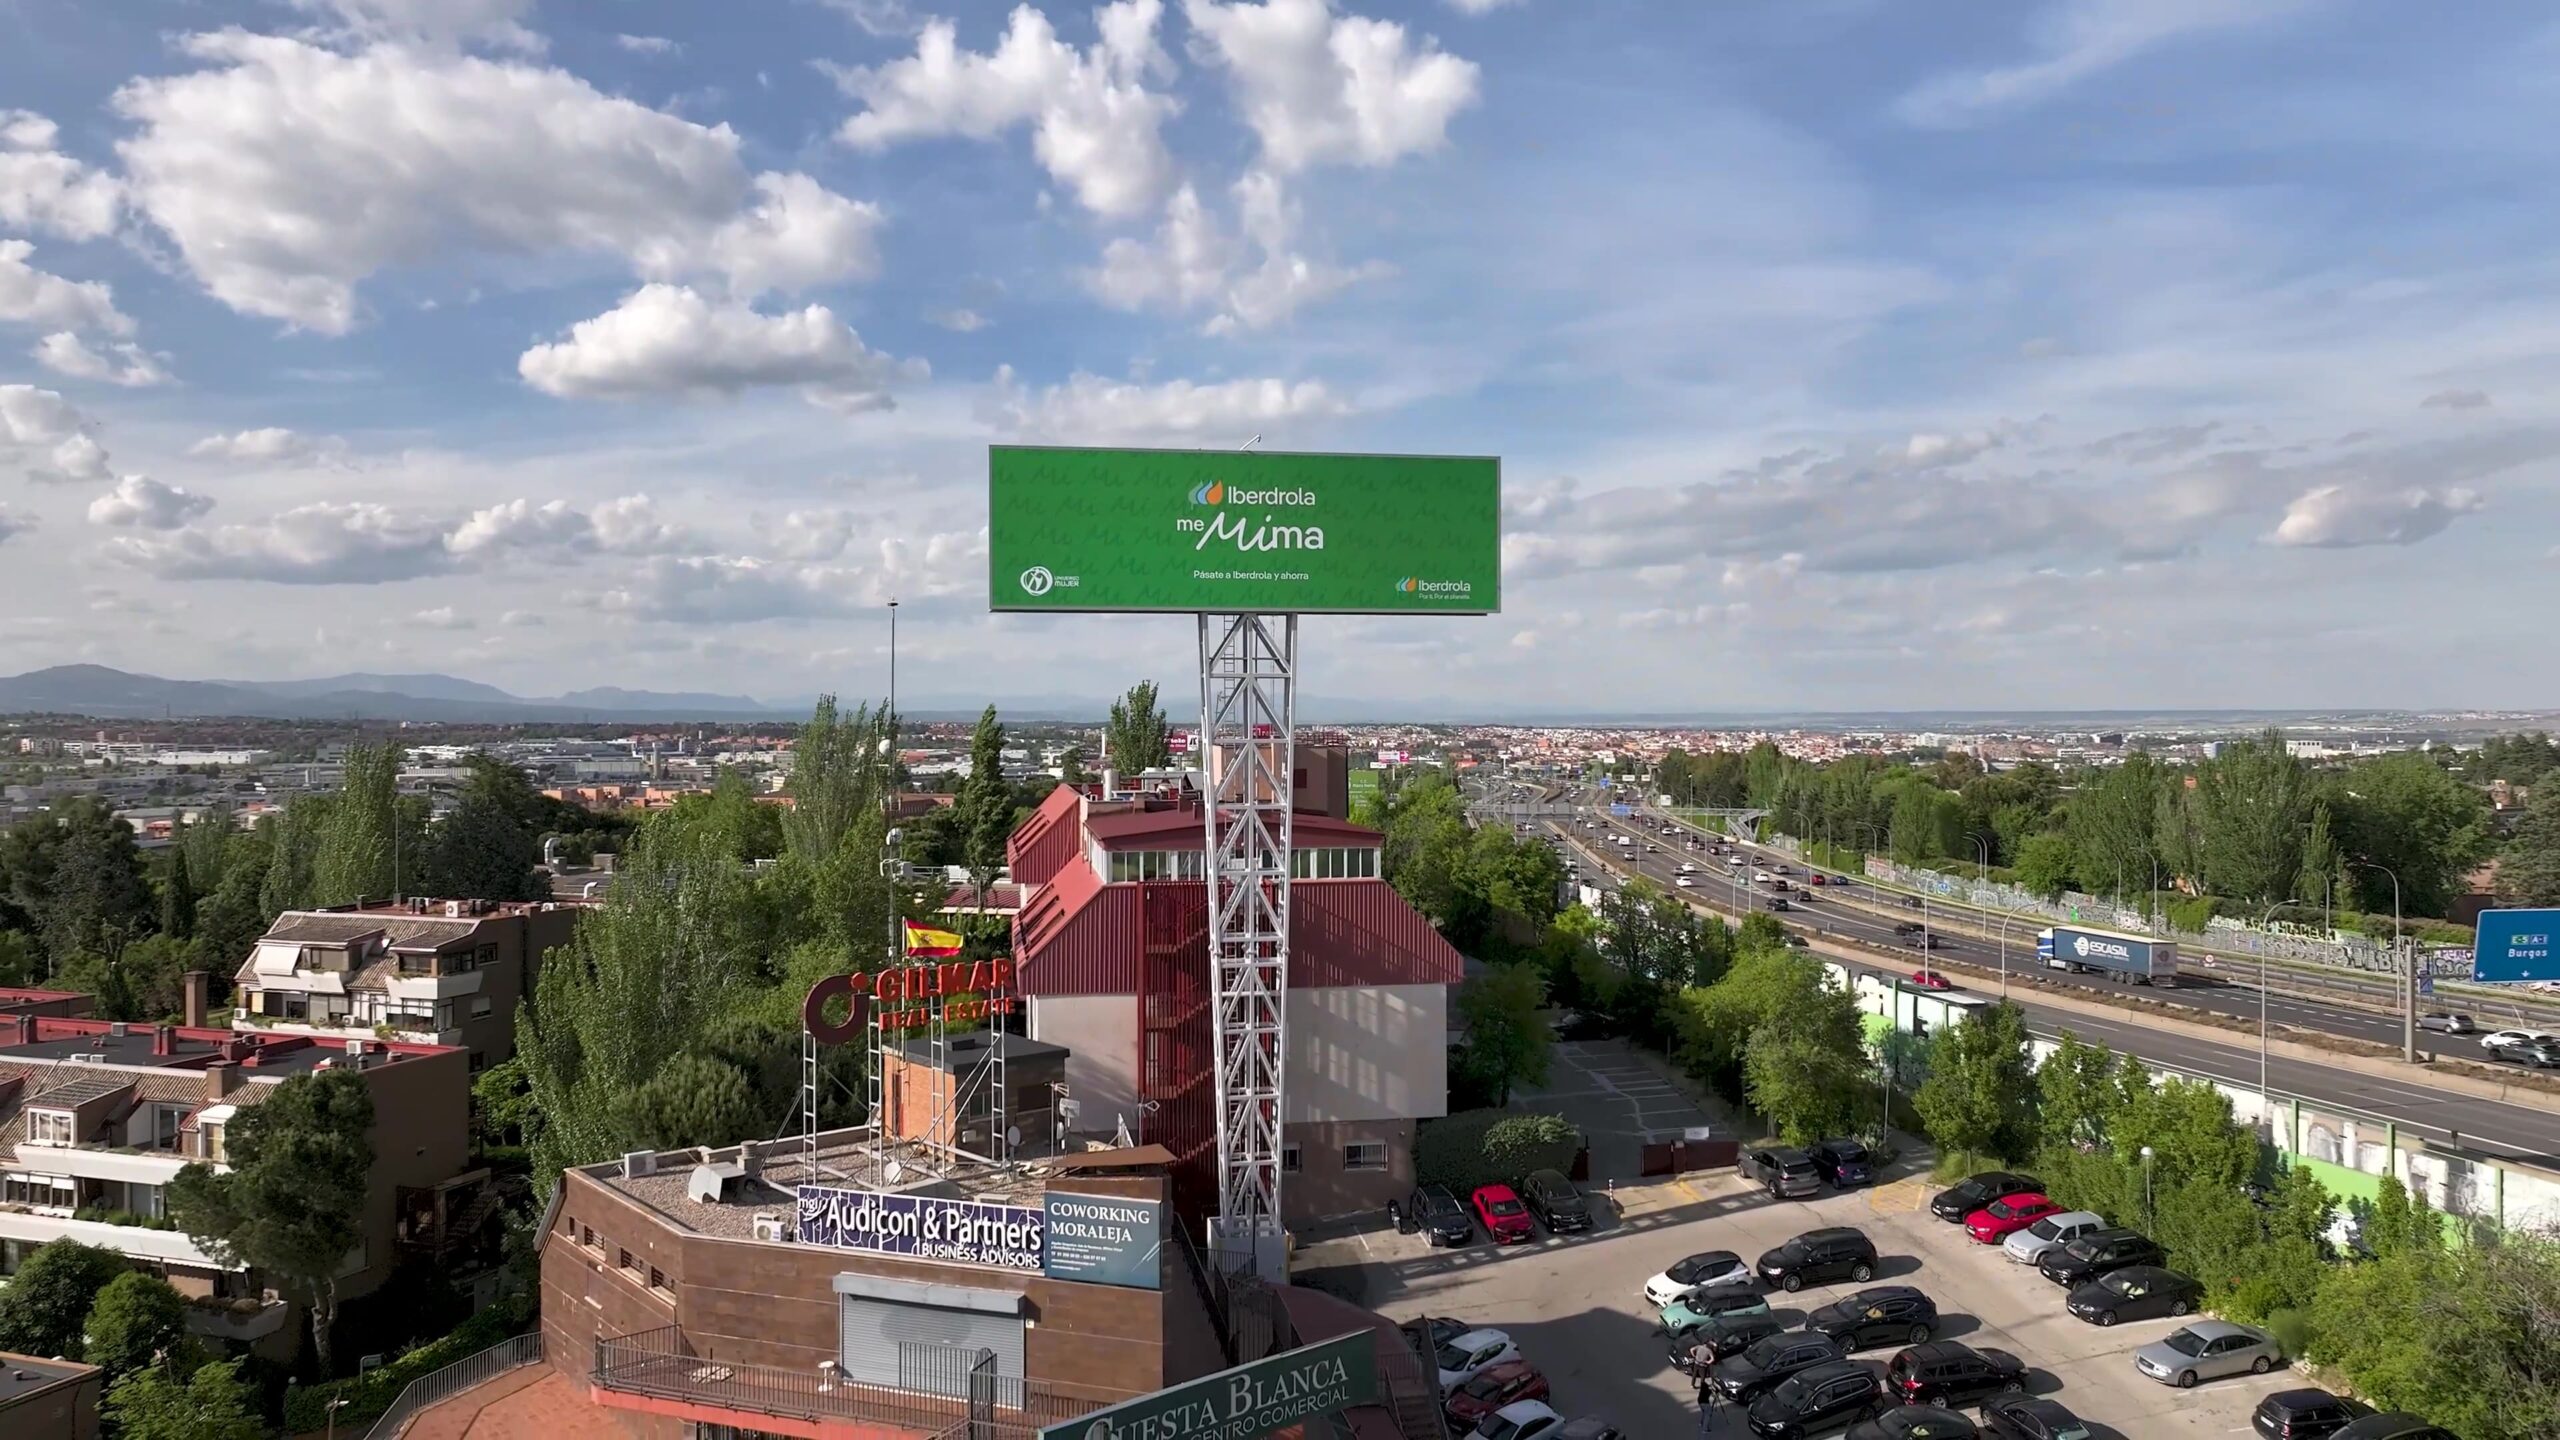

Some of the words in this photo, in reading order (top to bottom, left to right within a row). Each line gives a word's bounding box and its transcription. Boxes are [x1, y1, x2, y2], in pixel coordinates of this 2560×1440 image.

[1228, 486, 1316, 506] Iberdrola
[1176, 518, 1205, 532] me
[1195, 511, 1324, 552] Mima
[1193, 569, 1224, 580] Pásate
[1232, 570, 1273, 580] Iberdrola
[1274, 572, 1280, 582] y
[1280, 571, 1309, 580] ahorra
[1418, 579, 1471, 592] Iberdrola
[2508, 948, 2548, 960] Burgos
[877, 958, 1013, 1002] GILMAR
[944, 997, 1015, 1023] ESTATE
[826, 1196, 917, 1238] Audicon
[923, 1206, 940, 1240] &
[946, 1209, 1041, 1251] Partners
[1050, 1202, 1150, 1224] COWORKING
[1050, 1221, 1133, 1244] MORALEJA
[921, 1242, 978, 1261] BUSINESS
[980, 1250, 1041, 1269] ADVISORS
[1226, 1355, 1349, 1419] BLANCA
[1260, 1386, 1350, 1428] COMERCIAL
